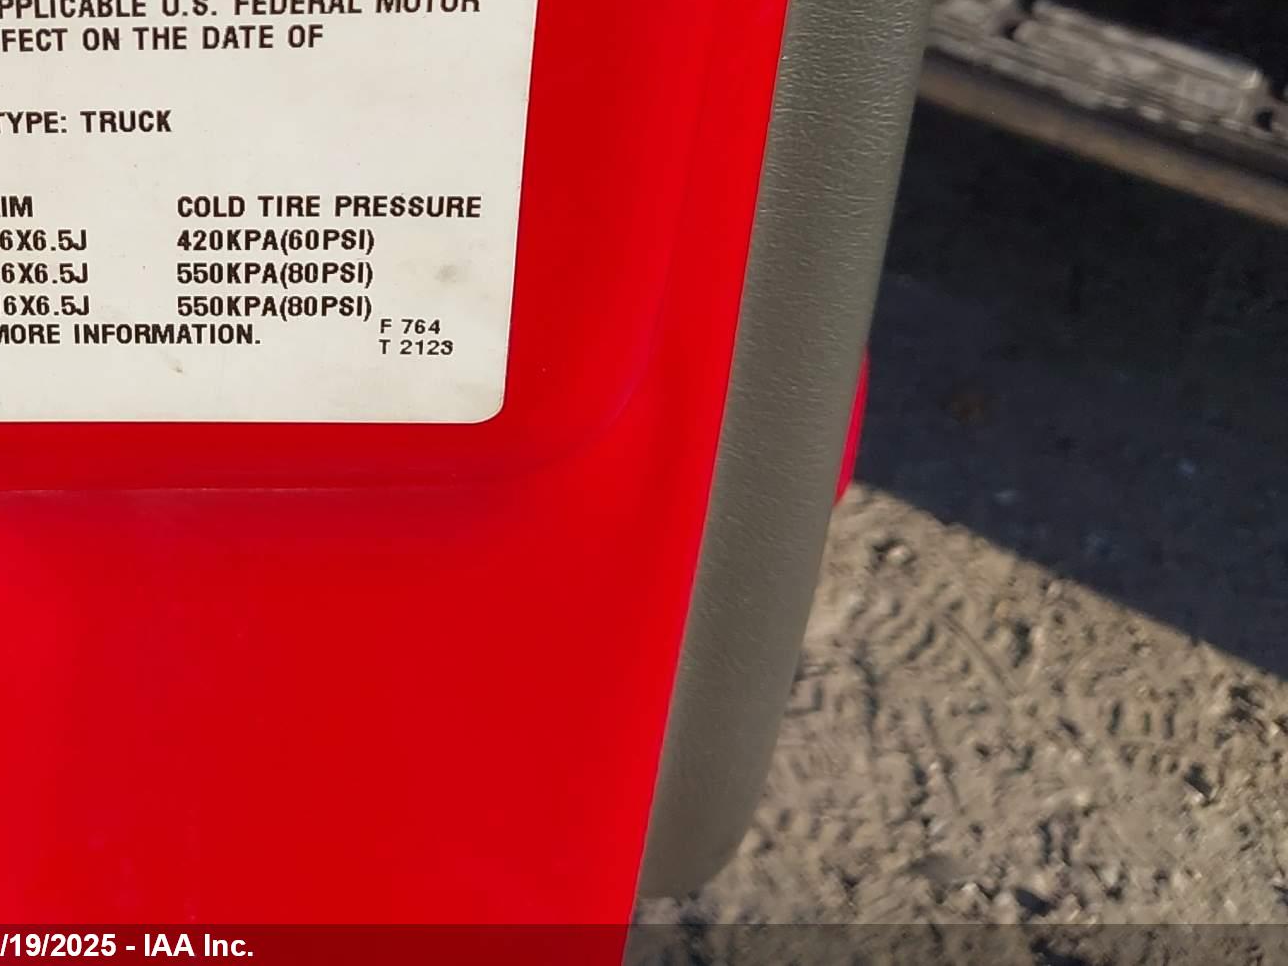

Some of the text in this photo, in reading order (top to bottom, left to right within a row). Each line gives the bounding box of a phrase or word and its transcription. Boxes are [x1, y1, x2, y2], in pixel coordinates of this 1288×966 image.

[83, 28, 119, 50] ON
[133, 27, 186, 50] THE
[203, 25, 273, 49] DATE
[289, 25, 323, 47] OF
[80, 111, 171, 132] TRUCK
[178, 196, 481, 217] COLD TIRE PRESSURE
[177, 229, 374, 255] 420KPA(60PSI)
[178, 262, 372, 289] 550KPA(80PSI)
[178, 296, 371, 321] 550KPA(80PSI)
[75, 324, 260, 344] INFORMATION.
[381, 319, 440, 334] F 764
[379, 339, 390, 354] T
